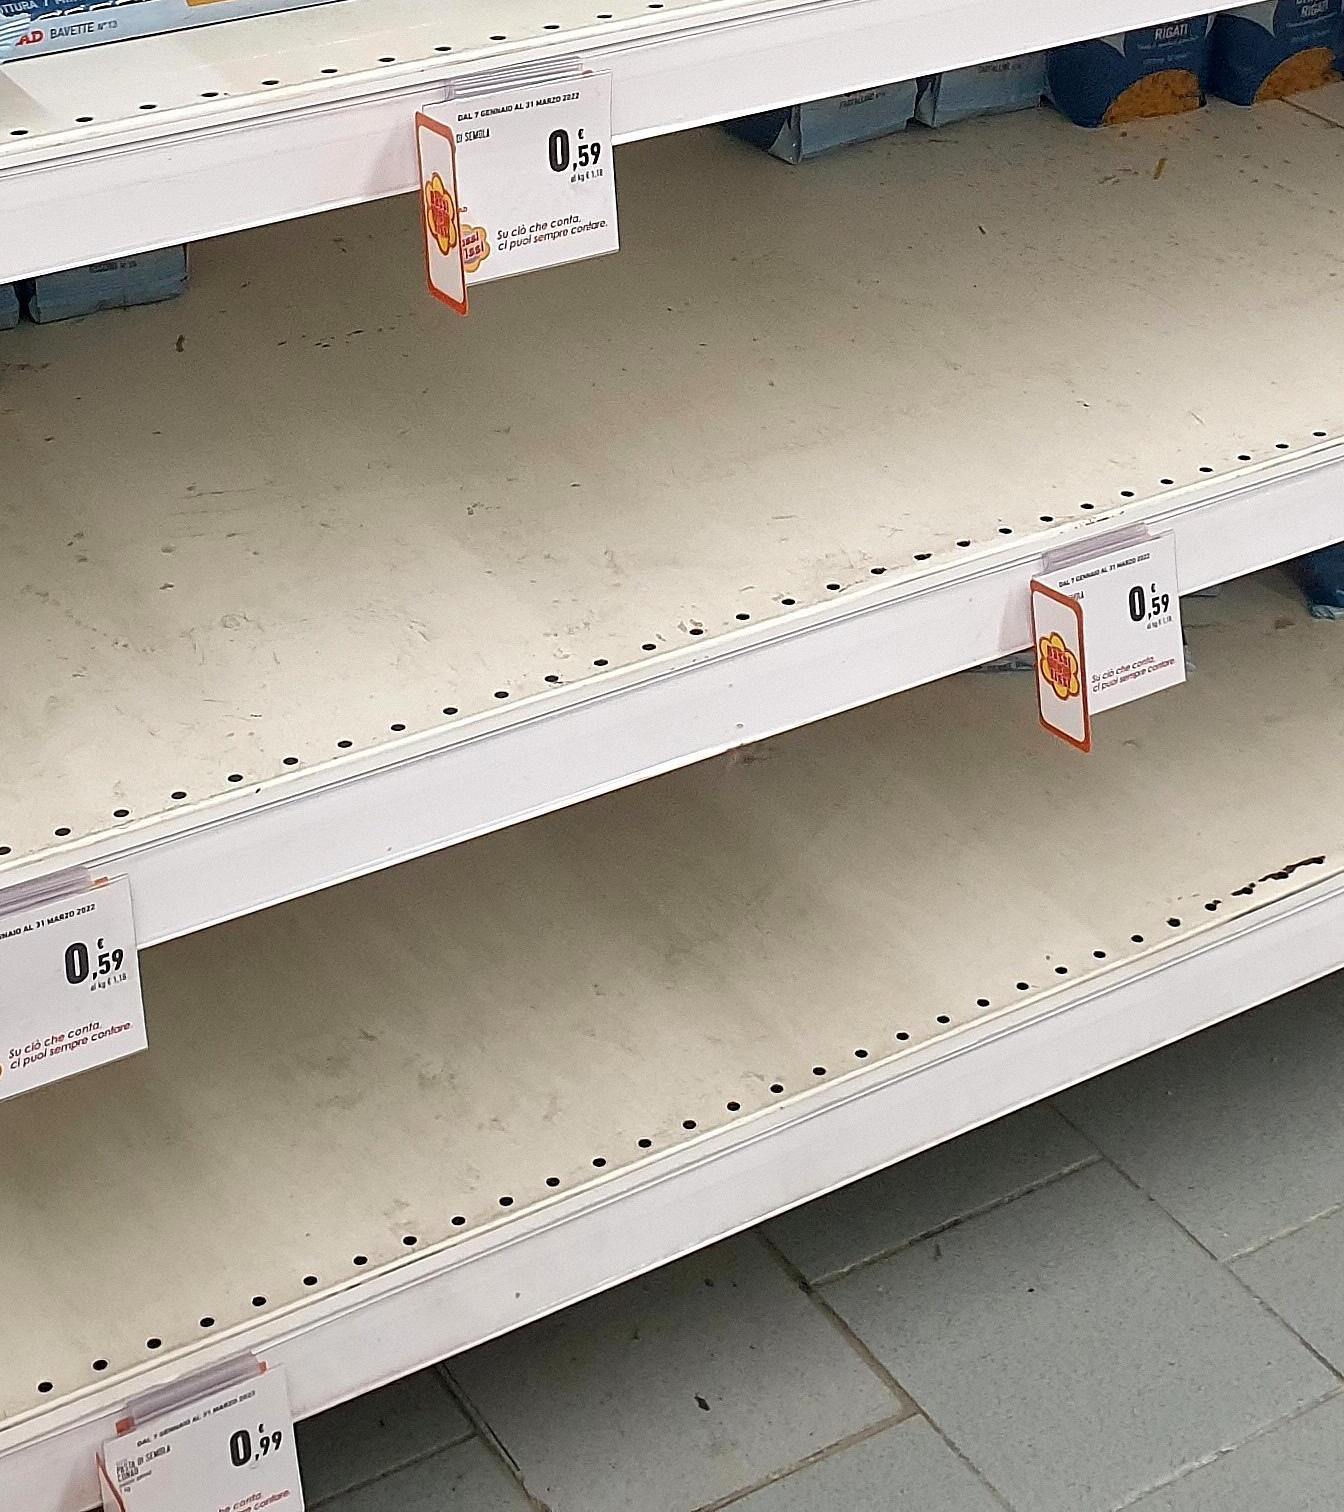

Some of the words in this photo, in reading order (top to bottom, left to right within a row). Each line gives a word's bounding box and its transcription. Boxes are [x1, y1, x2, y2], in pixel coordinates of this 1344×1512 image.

[50, 22, 94, 40] BAVETTE
[1155, 23, 1189, 40] RIGATI
[458, 113, 472, 122] DAL
[480, 105, 513, 118] GENNAIO
[536, 96, 561, 107] MARZO
[548, 128, 601, 172] 0,59
[497, 229, 509, 241] Su
[529, 220, 548, 233] che
[509, 236, 532, 251] puoi
[534, 228, 569, 244] sempre
[570, 219, 608, 235] contare.
[1059, 578, 1070, 588] DAL
[1129, 586, 1169, 621] 0,59
[47, 910, 75, 926] MARZO
[64, 942, 124, 985] 0,59
[8, 1047, 21, 1060] Su
[24, 1040, 42, 1056] ciò
[44, 1032, 66, 1048] che
[10, 1058, 21, 1069] ci
[22, 1050, 48, 1068] puoi
[49, 1037, 89, 1059] sempre
[229, 1430, 284, 1467] 0,99
